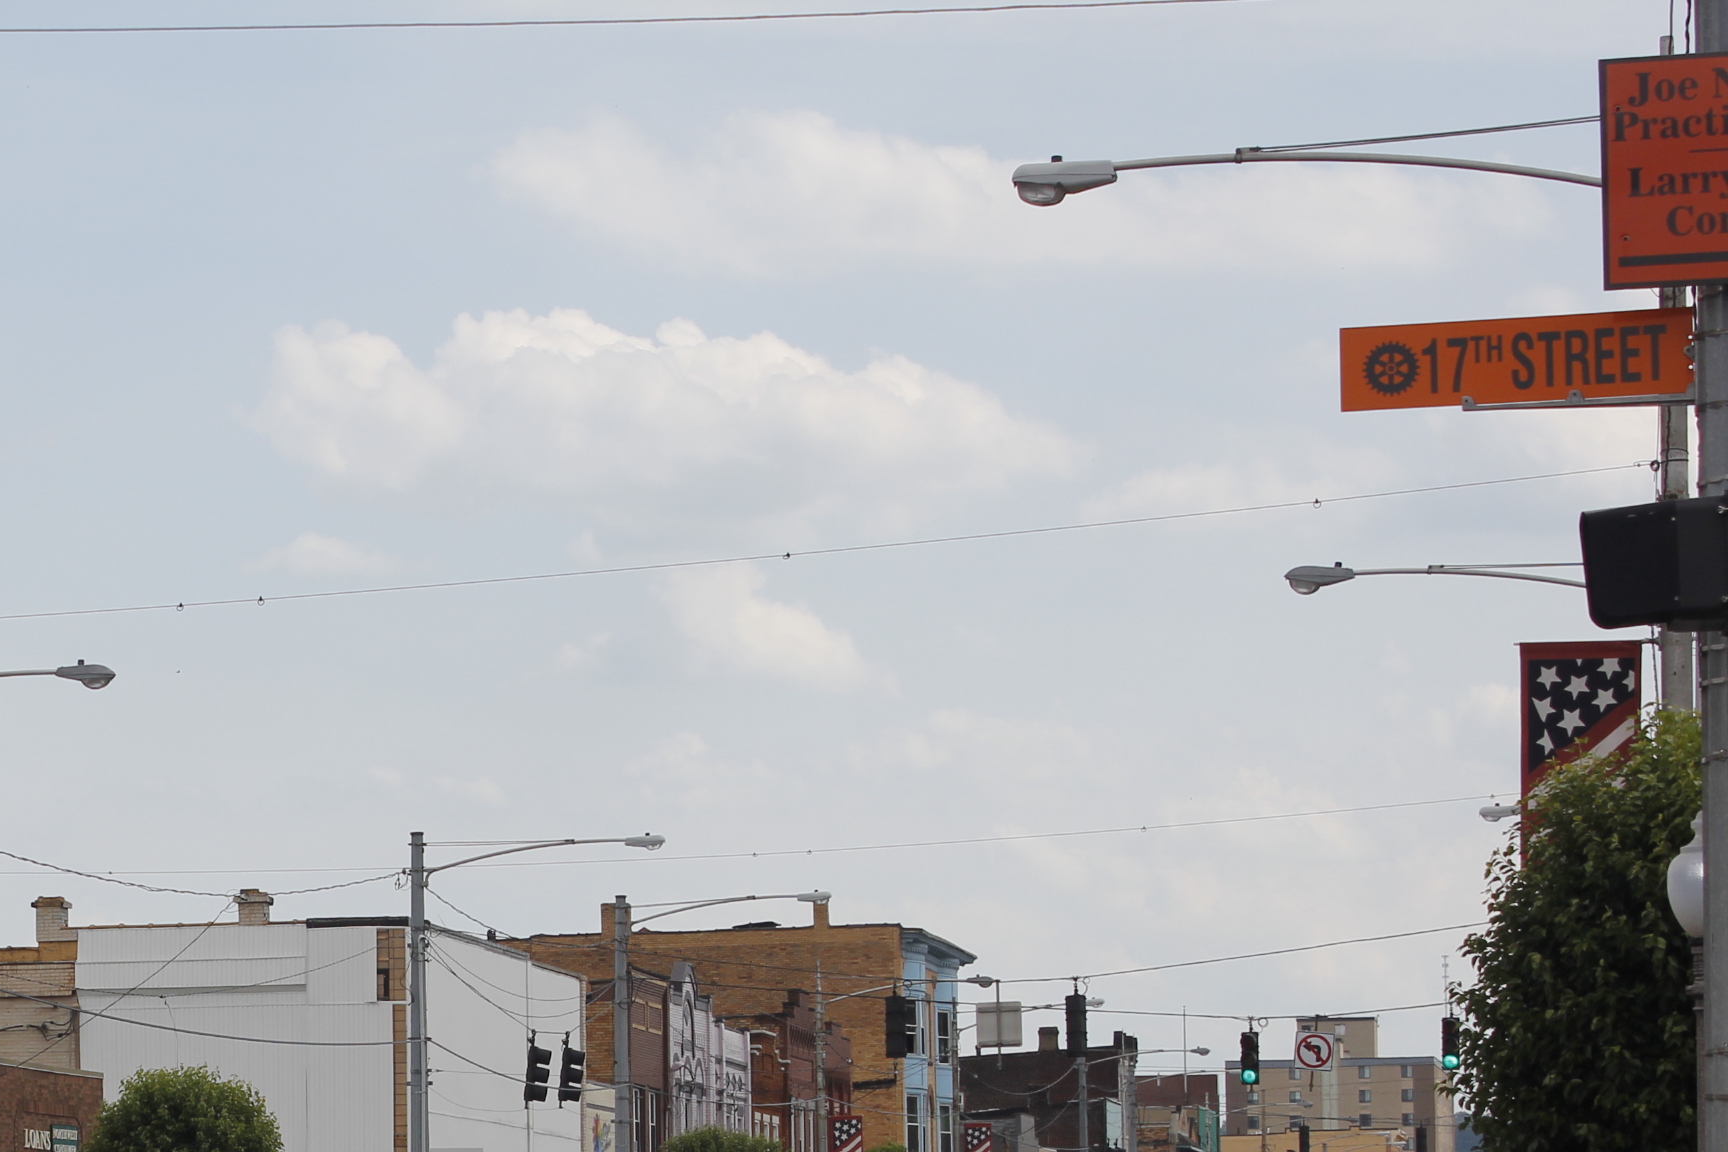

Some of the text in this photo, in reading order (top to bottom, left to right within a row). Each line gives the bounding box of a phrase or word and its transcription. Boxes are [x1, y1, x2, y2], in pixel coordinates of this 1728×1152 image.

[1628, 71, 1699, 107] Joe
[1422, 323, 1668, 394] 17TH STREET
[23, 1127, 51, 1150] LOANS
